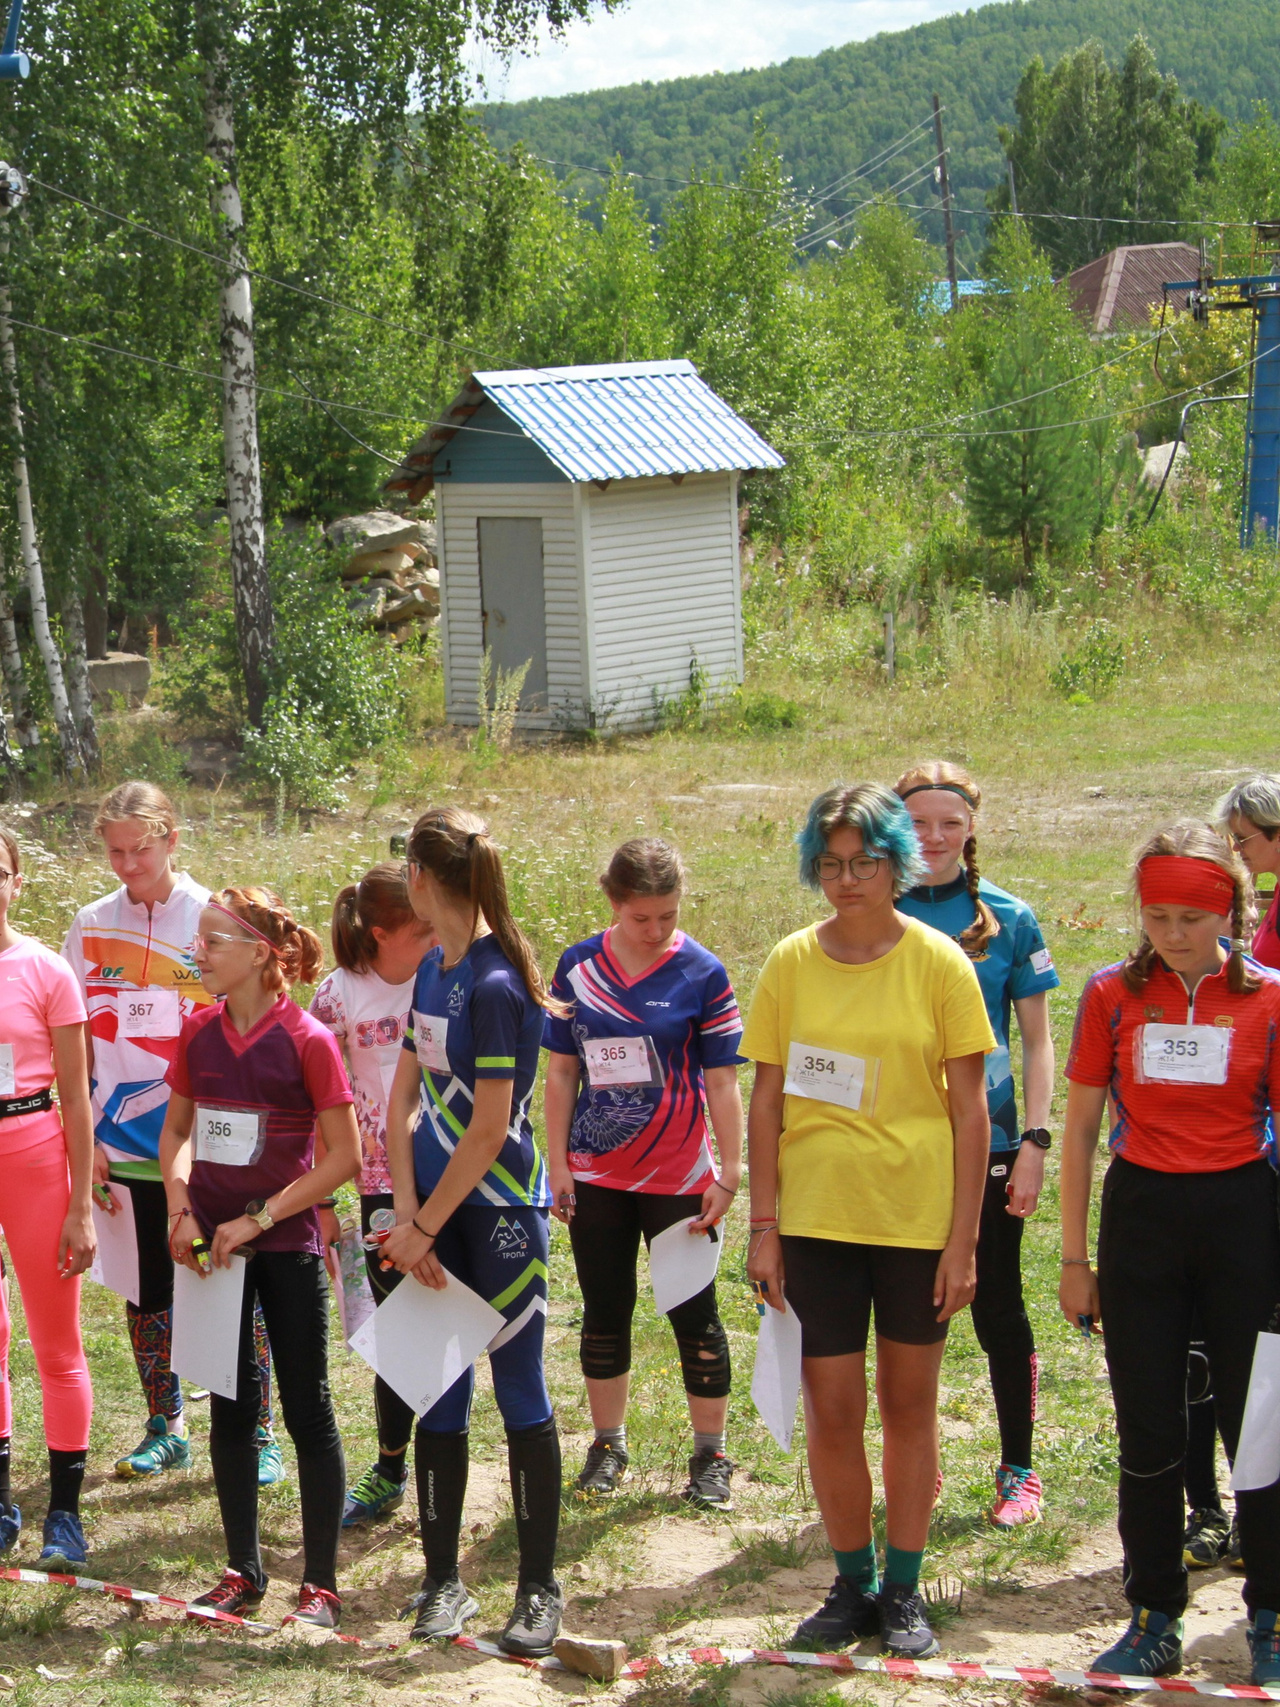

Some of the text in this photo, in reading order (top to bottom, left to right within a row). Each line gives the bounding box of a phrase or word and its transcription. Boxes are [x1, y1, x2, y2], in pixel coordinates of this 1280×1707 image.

[128, 1003, 154, 1016] 367
[600, 1046, 627, 1061] 365
[1163, 1039, 1199, 1057] 353
[804, 1055, 836, 1075] 354
[207, 1120, 232, 1137] 356
